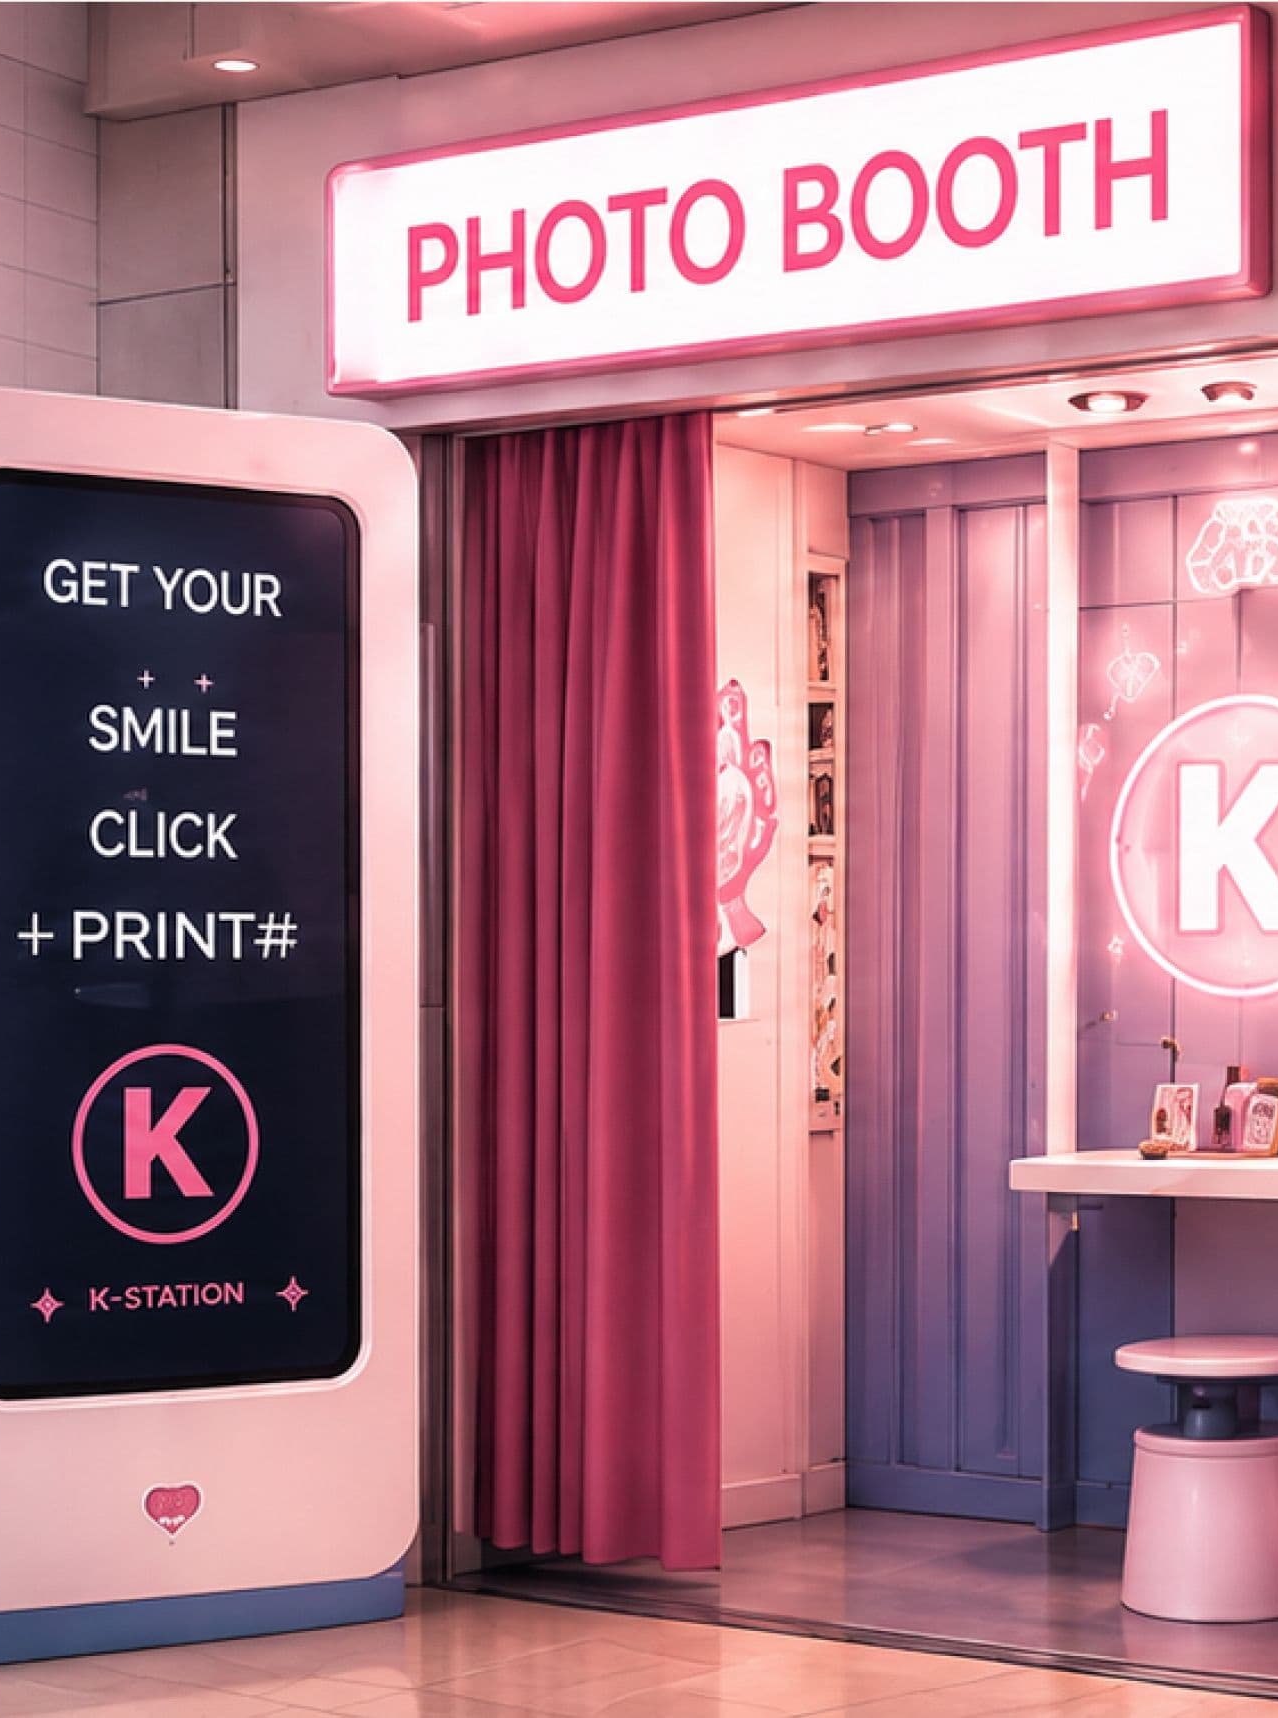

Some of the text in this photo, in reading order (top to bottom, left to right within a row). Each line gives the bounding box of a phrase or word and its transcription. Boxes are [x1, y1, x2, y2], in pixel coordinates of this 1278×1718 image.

[406, 107, 1170, 323] PHOTO BOOTH
[43, 557, 283, 618] GET YOUR
[87, 703, 239, 757] SMILE
[88, 808, 239, 860] CLICK
[123, 1086, 215, 1200] K
[89, 1281, 246, 1312] K-STATION
